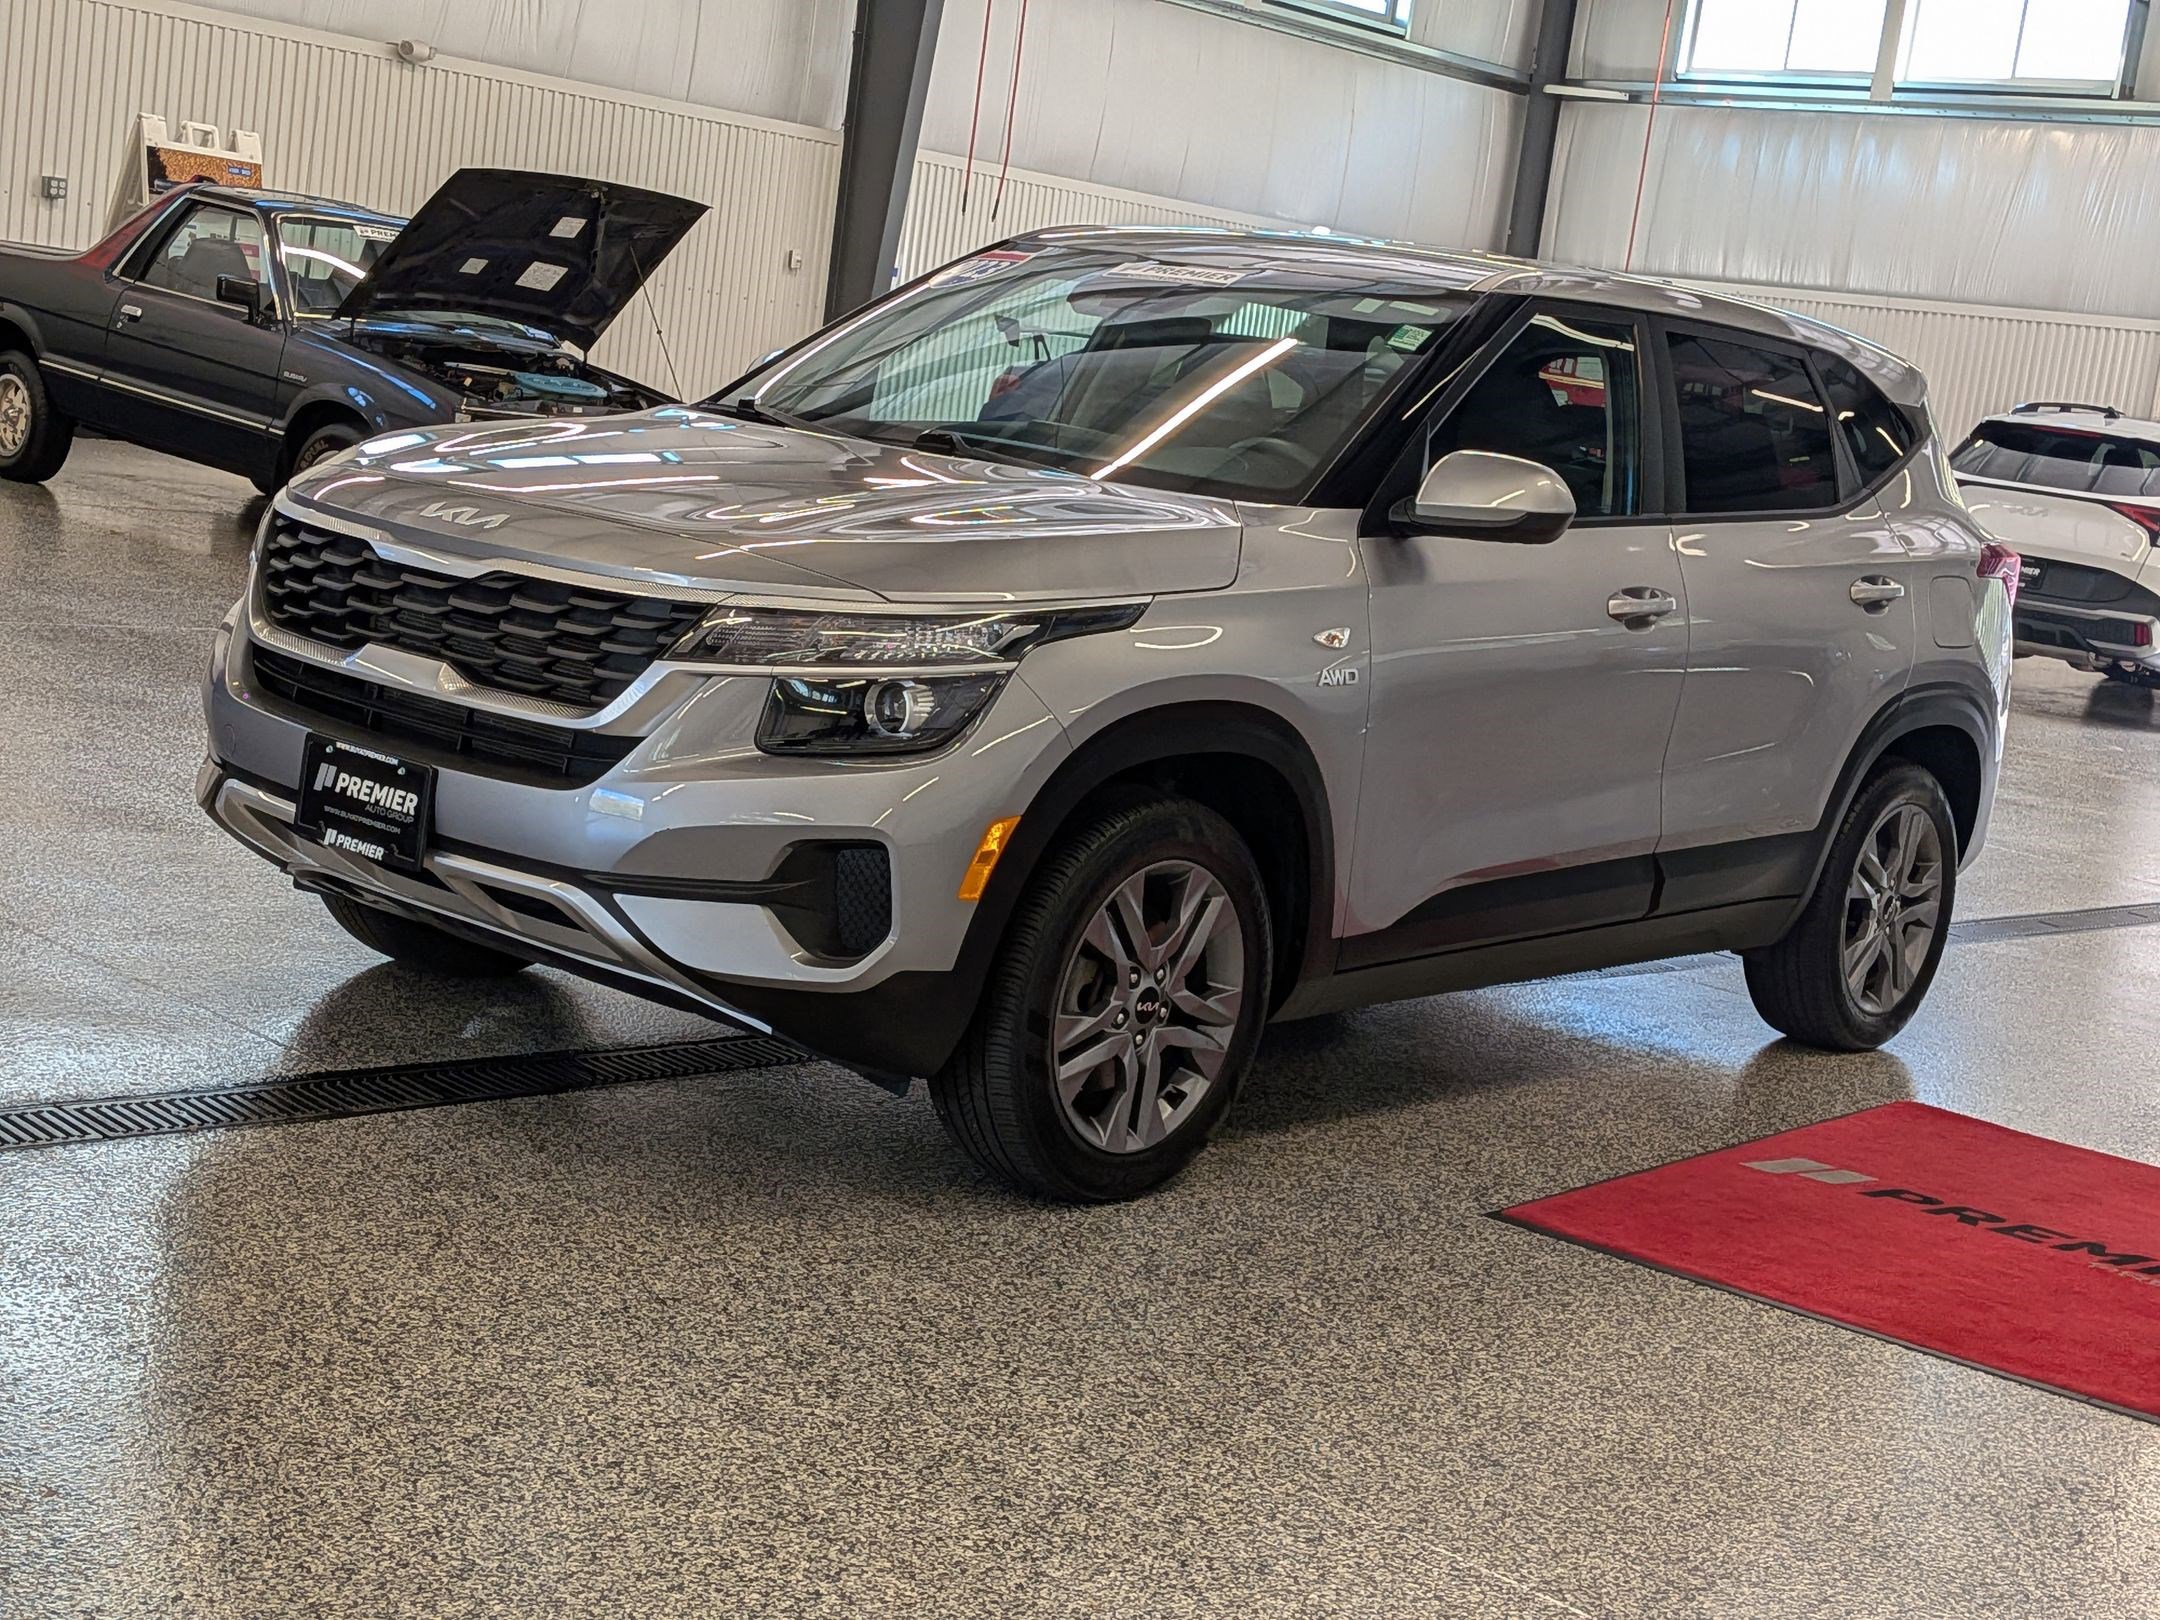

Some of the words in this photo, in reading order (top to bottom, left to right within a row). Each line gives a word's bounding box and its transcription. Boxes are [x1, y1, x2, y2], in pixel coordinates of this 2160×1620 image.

[370, 229, 397, 237] PREM
[1142, 265, 1238, 281] PREMIER
[419, 501, 511, 529] KIA
[1318, 668, 1360, 687] AWD
[334, 772, 419, 816] PREMIER
[364, 803, 387, 817] AUTO
[386, 808, 415, 824] GROUP
[335, 834, 385, 861] PREMIER
